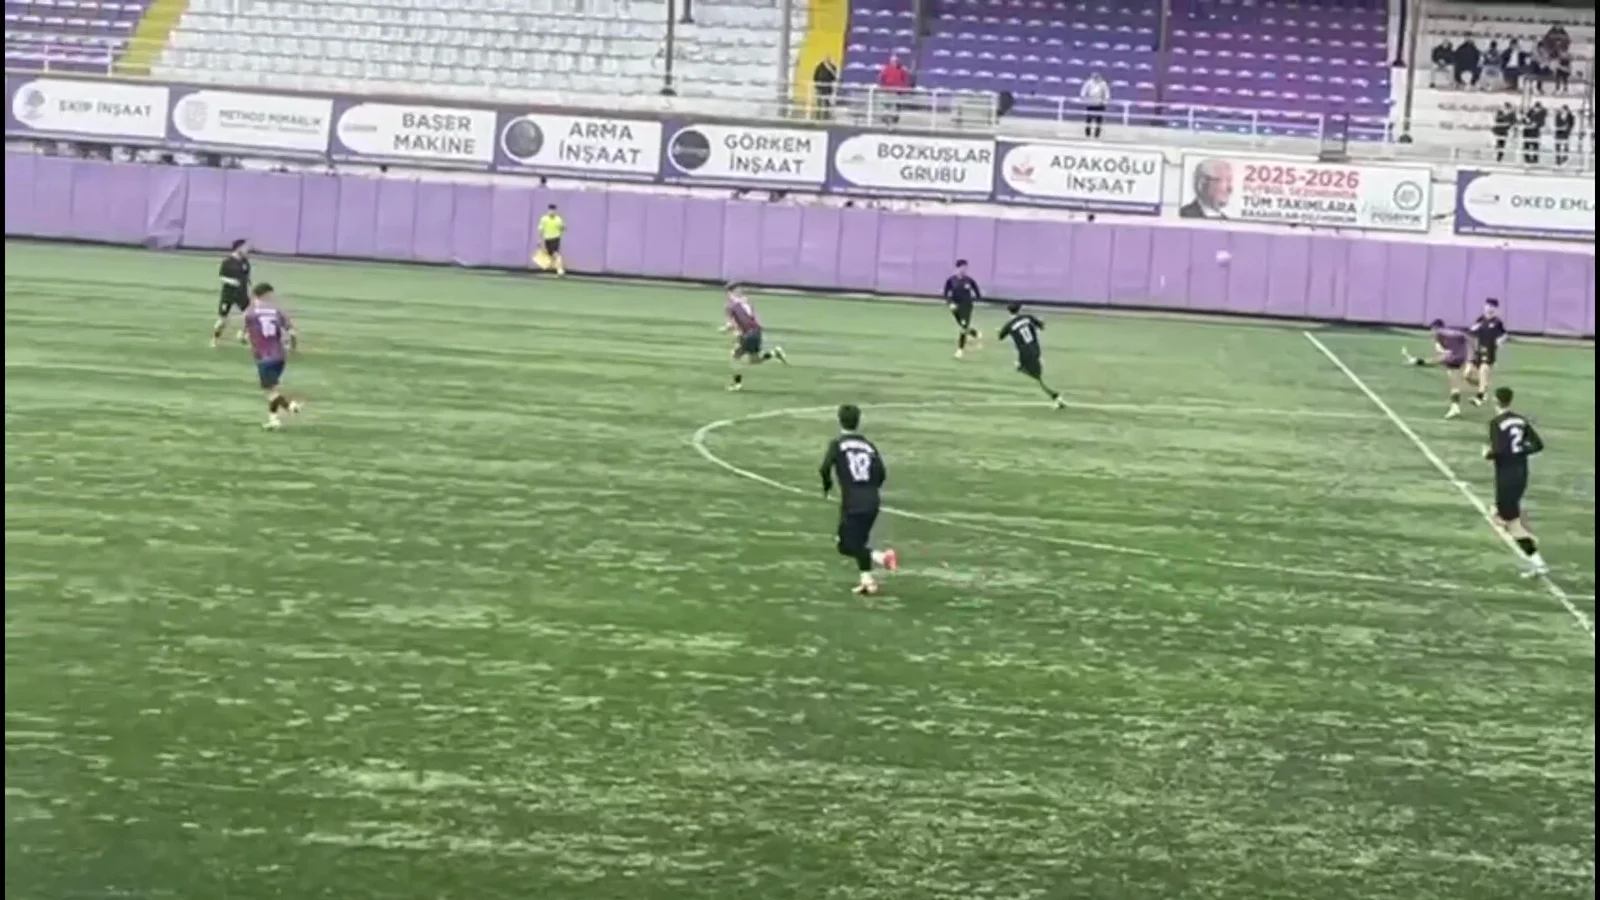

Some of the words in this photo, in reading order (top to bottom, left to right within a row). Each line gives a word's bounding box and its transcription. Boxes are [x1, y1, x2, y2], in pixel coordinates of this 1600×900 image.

[568, 120, 633, 140] ARMA
[724, 132, 811, 153] GÖRKEM
[899, 165, 966, 184] GRUBU
[1050, 155, 1155, 175] ADAKOĞLU
[1244, 165, 1360, 189] 2025-2026
[1511, 195, 1556, 209] OKED
[1510, 427, 1523, 453] 2
